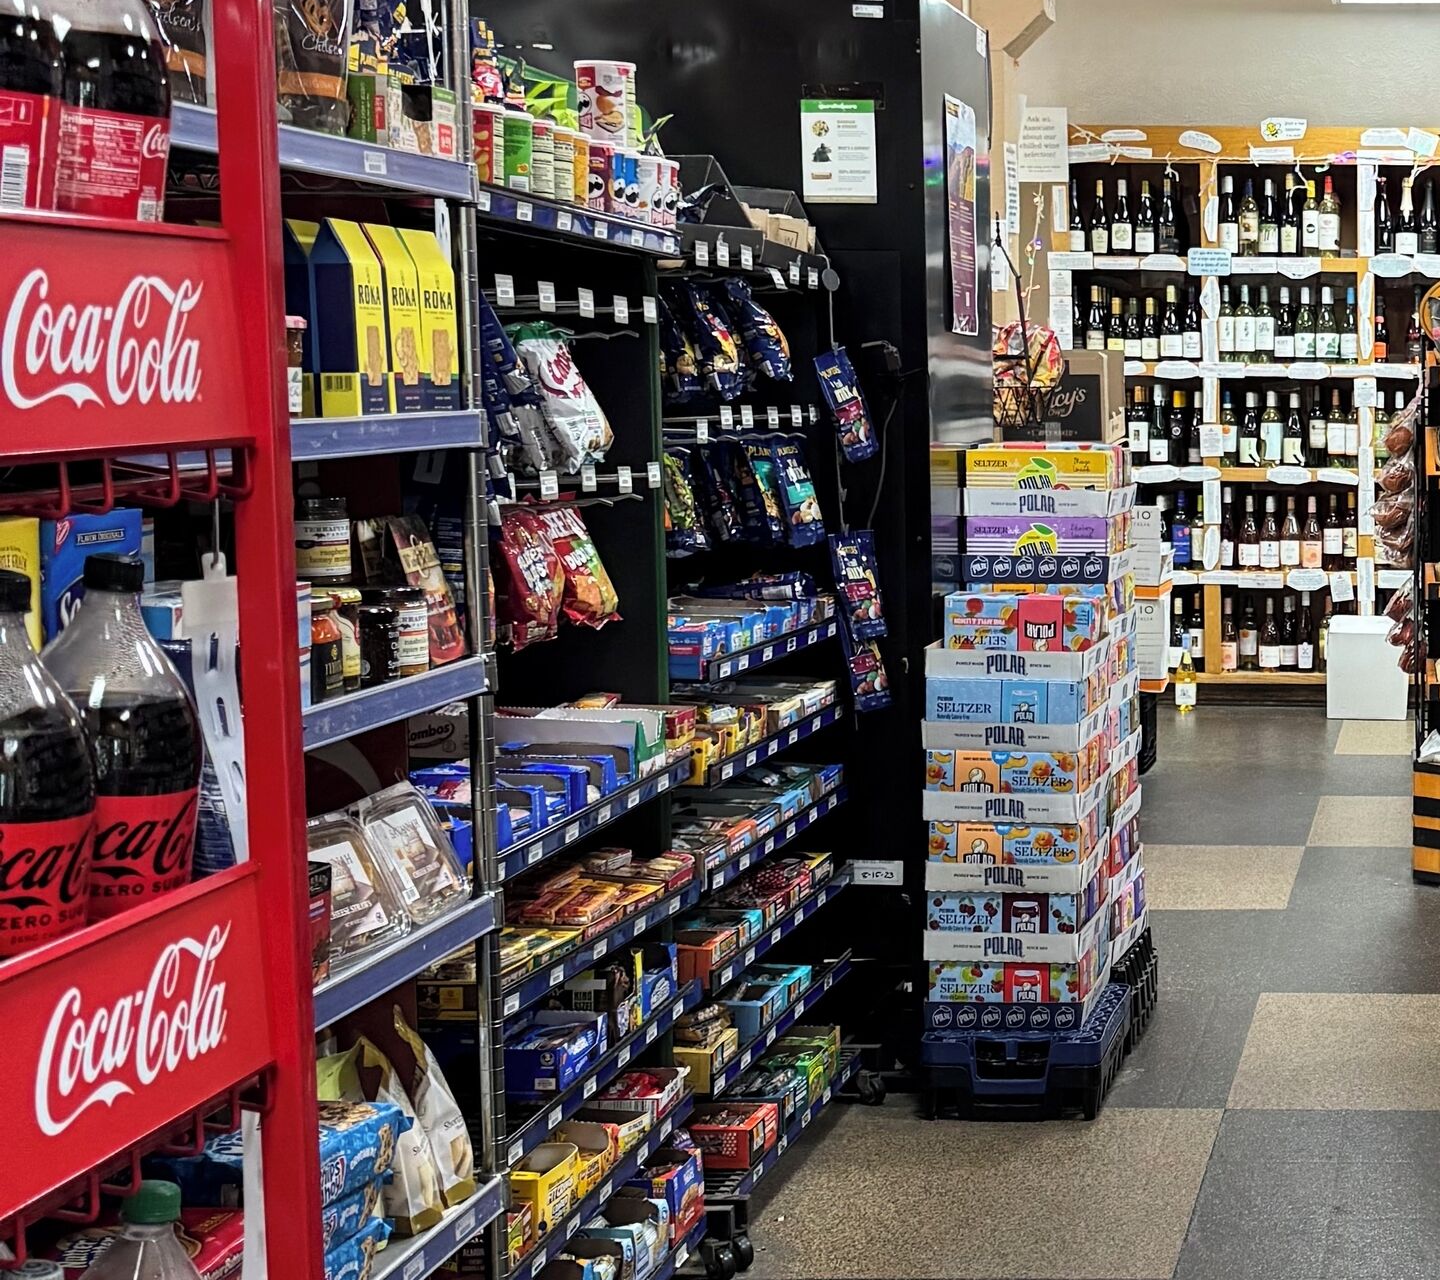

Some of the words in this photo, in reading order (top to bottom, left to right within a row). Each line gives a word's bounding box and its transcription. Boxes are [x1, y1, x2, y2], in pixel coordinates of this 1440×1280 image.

[358, 284, 381, 306] ROKA
[392, 285, 416, 308] ROKA
[424, 289, 453, 310] ROKA
[1, 268, 203, 410] Coca-Cola
[974, 459, 1008, 468] SELTZER
[1018, 474, 1053, 490] POLAR
[1019, 494, 1057, 514] POLAR
[974, 526, 1008, 535] SELTZER
[1026, 622, 1055, 637] POLAR
[986, 653, 1028, 675] POLAR
[936, 703, 992, 714] SELTZER
[985, 725, 1026, 747] POLAR
[1012, 776, 1067, 787] SELTZER
[985, 798, 1025, 819] POLAR
[1014, 846, 1070, 858] SELTZER
[984, 866, 1024, 888] POLAR
[938, 914, 993, 925] SELTZER
[984, 936, 1024, 957] POLAR
[939, 983, 994, 994] SELTZER
[35, 920, 232, 1136] Coca-Cola
